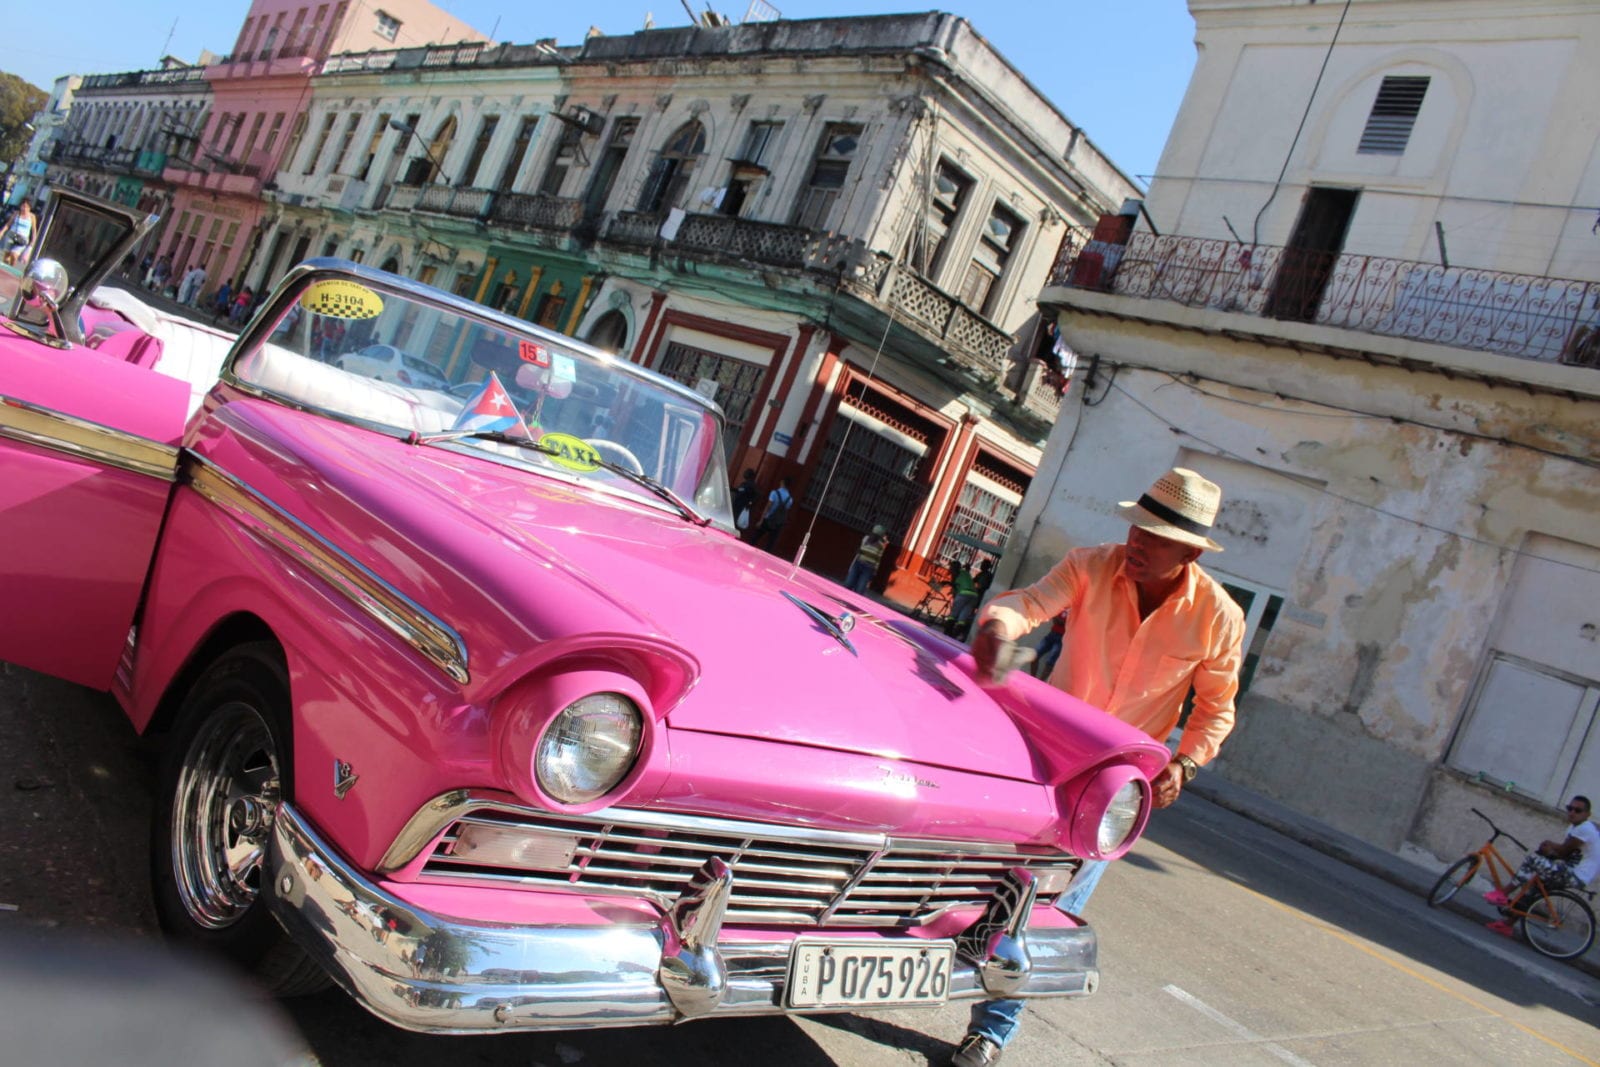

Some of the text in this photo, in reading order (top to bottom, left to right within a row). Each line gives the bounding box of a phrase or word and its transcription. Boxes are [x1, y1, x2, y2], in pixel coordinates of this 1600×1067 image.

[320, 293, 365, 306] H-3104
[520, 343, 537, 361] 15
[545, 438, 596, 466] TAXI
[801, 953, 811, 995] CUBA
